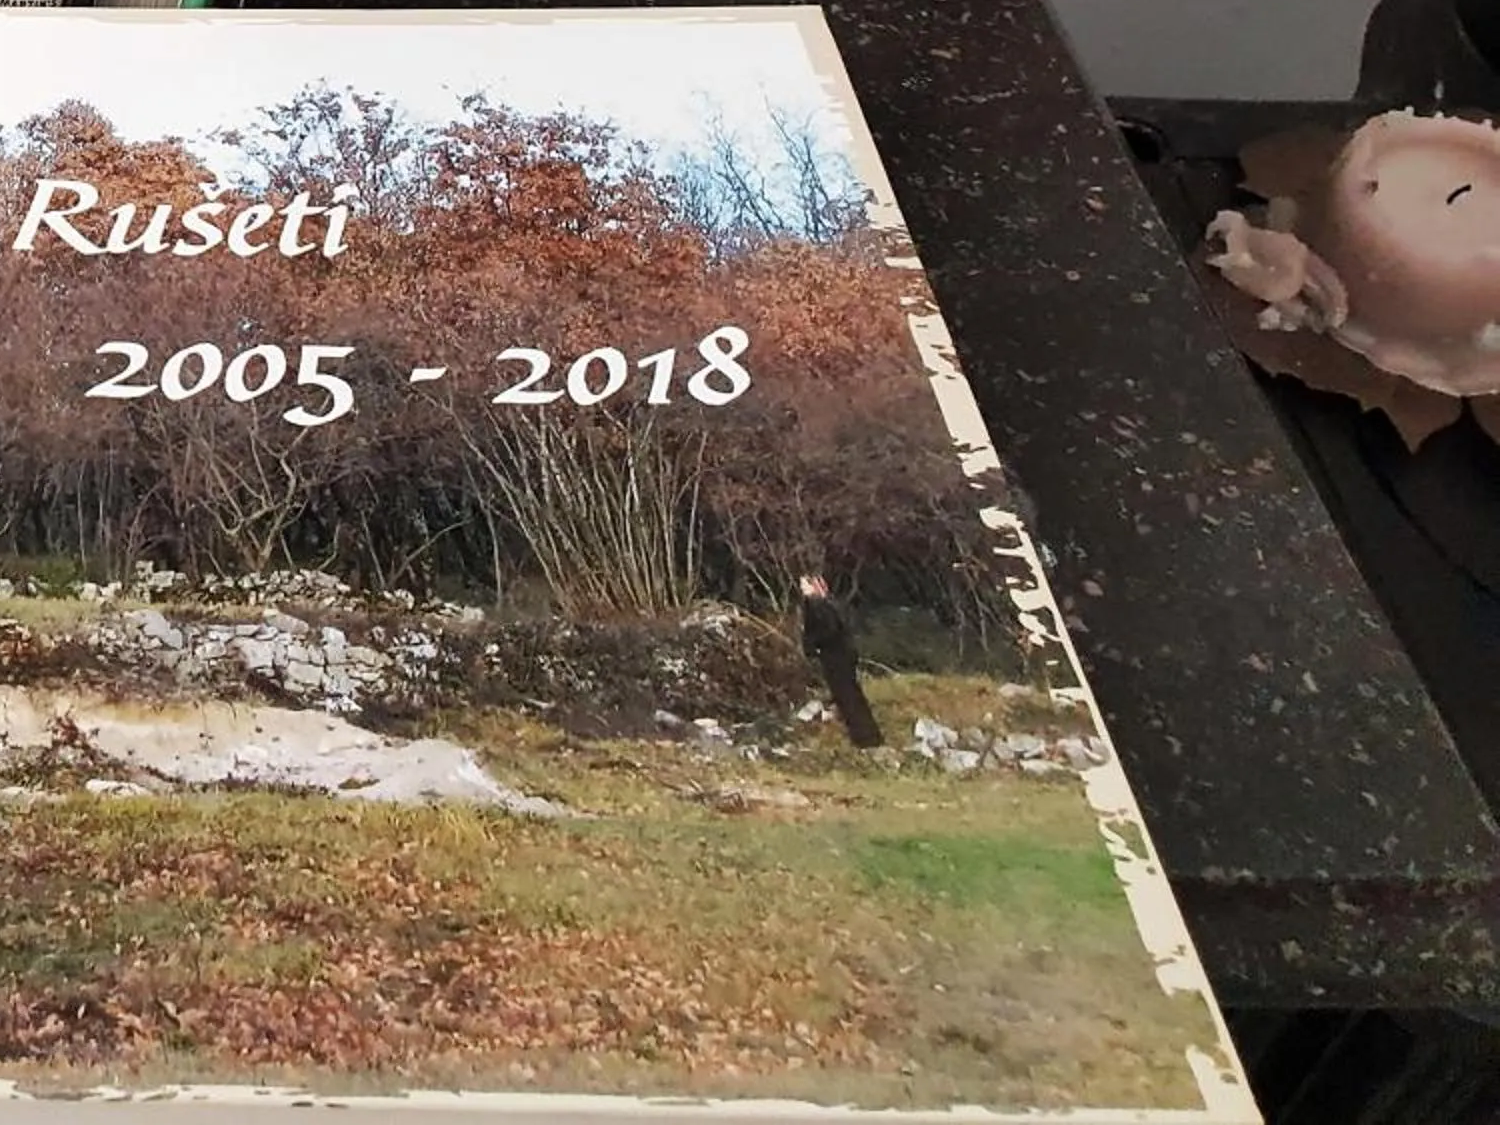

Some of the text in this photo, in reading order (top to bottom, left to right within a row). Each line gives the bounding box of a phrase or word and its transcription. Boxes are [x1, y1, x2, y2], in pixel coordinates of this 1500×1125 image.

[12, 171, 360, 259] Rušeti
[83, 341, 358, 427] 2005
[490, 326, 753, 406] 2018
